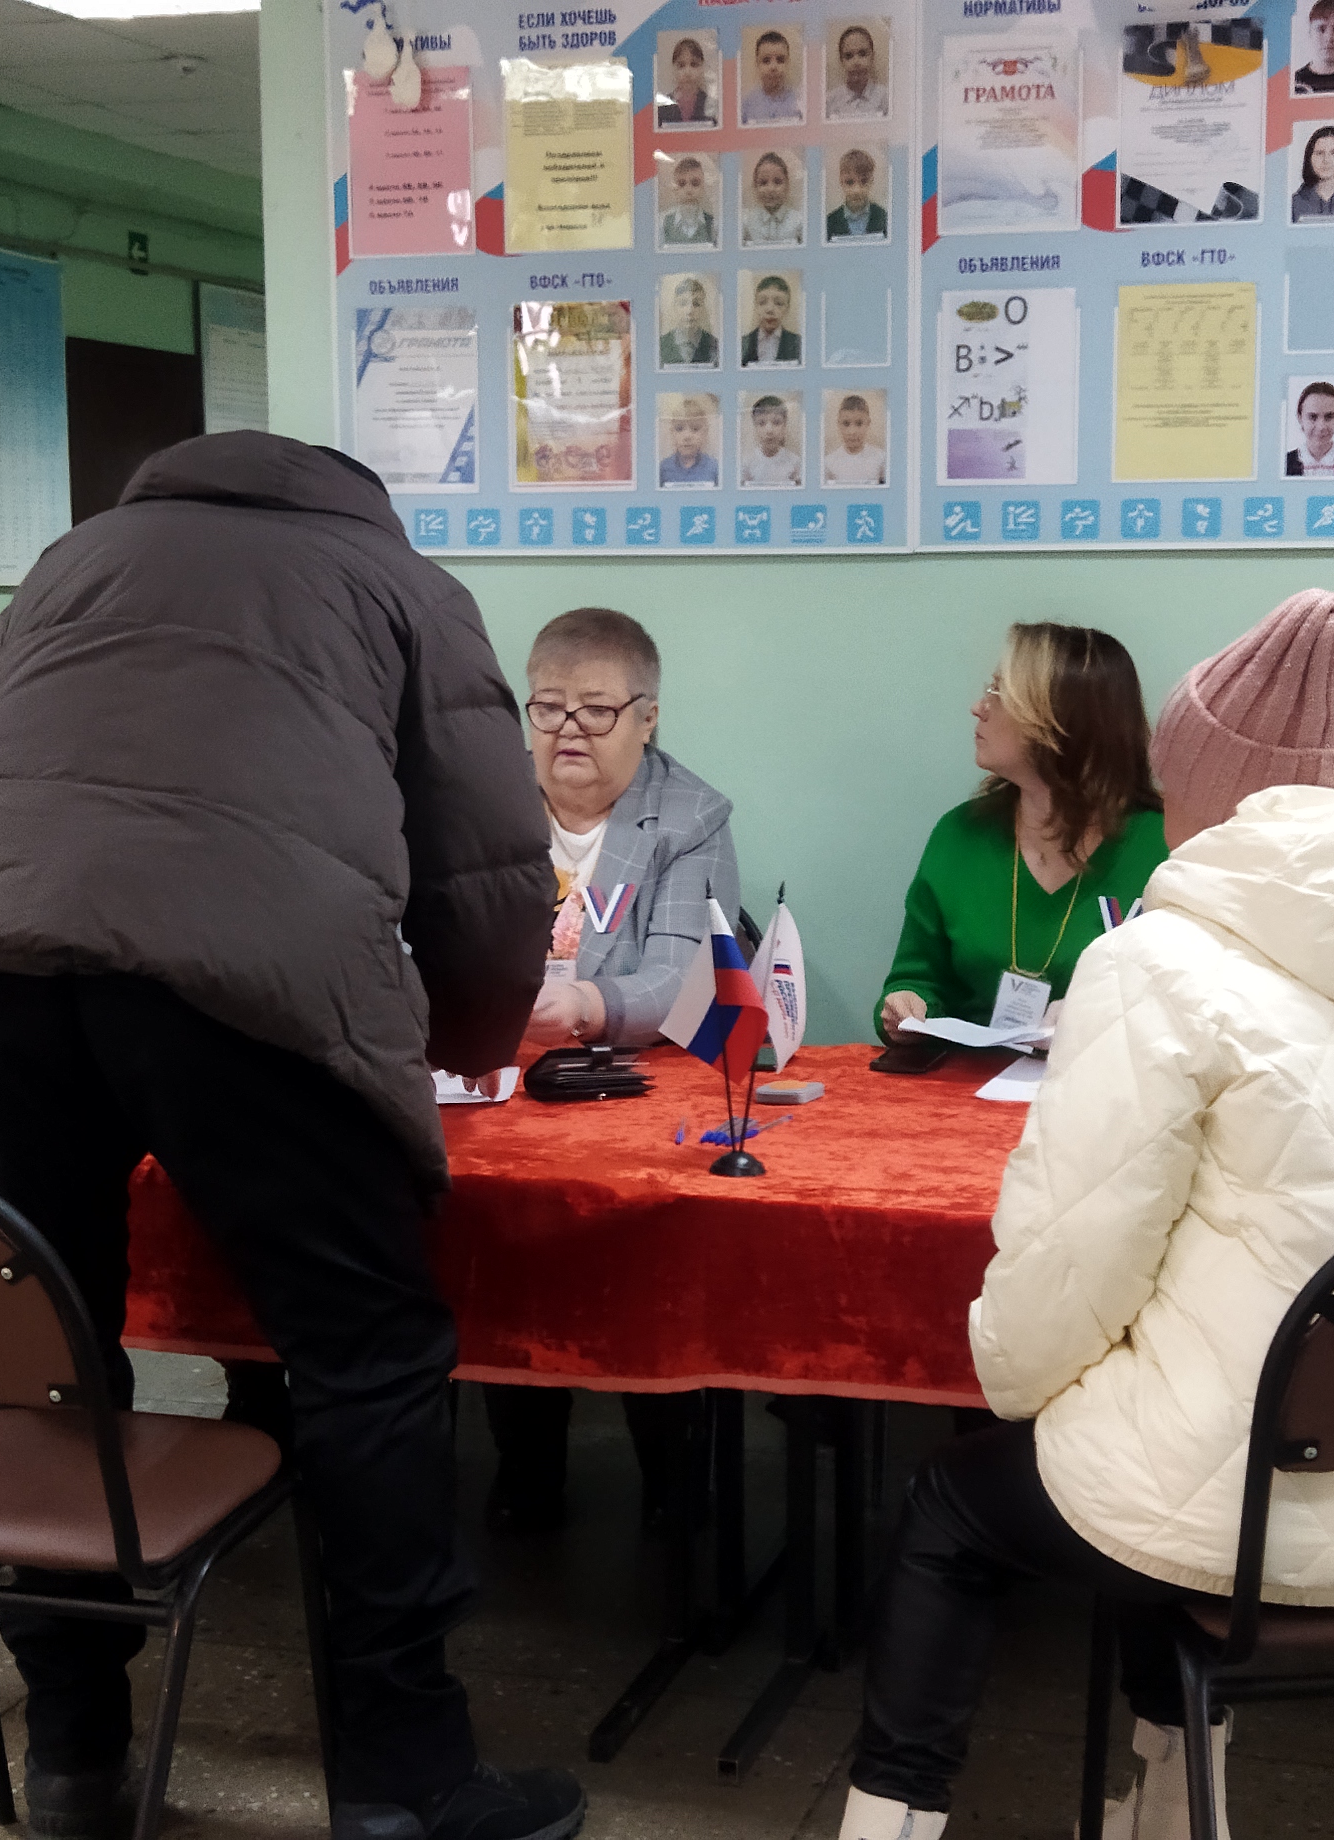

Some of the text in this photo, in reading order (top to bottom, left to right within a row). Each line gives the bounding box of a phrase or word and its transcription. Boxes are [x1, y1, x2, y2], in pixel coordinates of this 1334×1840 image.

[518, 8, 617, 30] ЕСЛИ ХОЧЕШЬ
[518, 30, 617, 52] БЫТЬ ЗДОРОВ
[962, 83, 1057, 104] ГРАМОТА
[958, 254, 1061, 273] ОБЪЯВЛЕНИЯ
[1140, 249, 1186, 268] ВФСК
[369, 276, 459, 295] ОБЪЯВЛЕНИЯ
[529, 273, 569, 290] ВФСК
